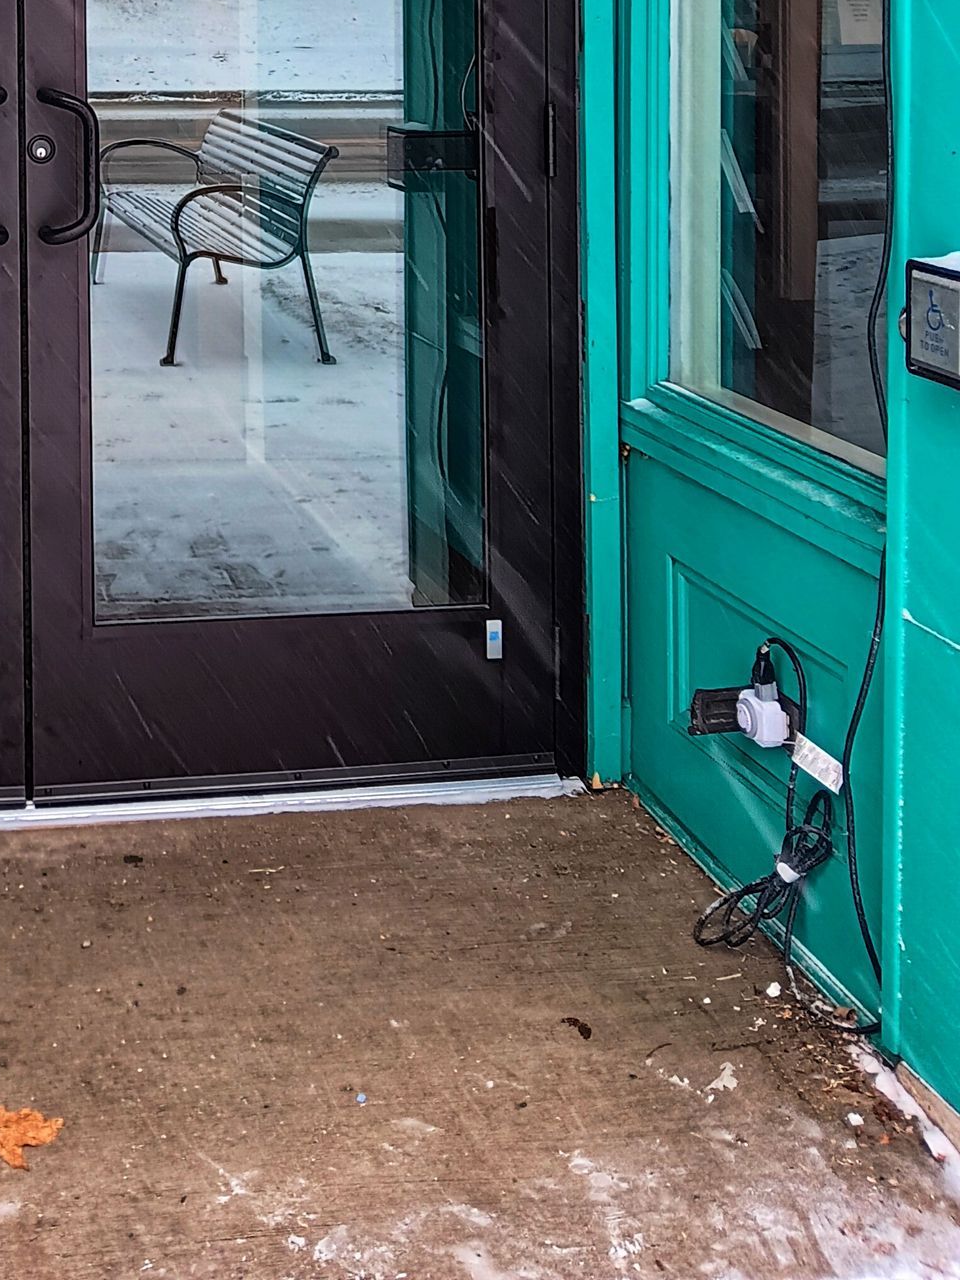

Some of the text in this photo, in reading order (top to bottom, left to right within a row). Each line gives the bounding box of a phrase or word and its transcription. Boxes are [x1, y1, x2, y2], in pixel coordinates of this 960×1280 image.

[925, 330, 944, 343] PUSH
[920, 339, 950, 357] TO OPEN
